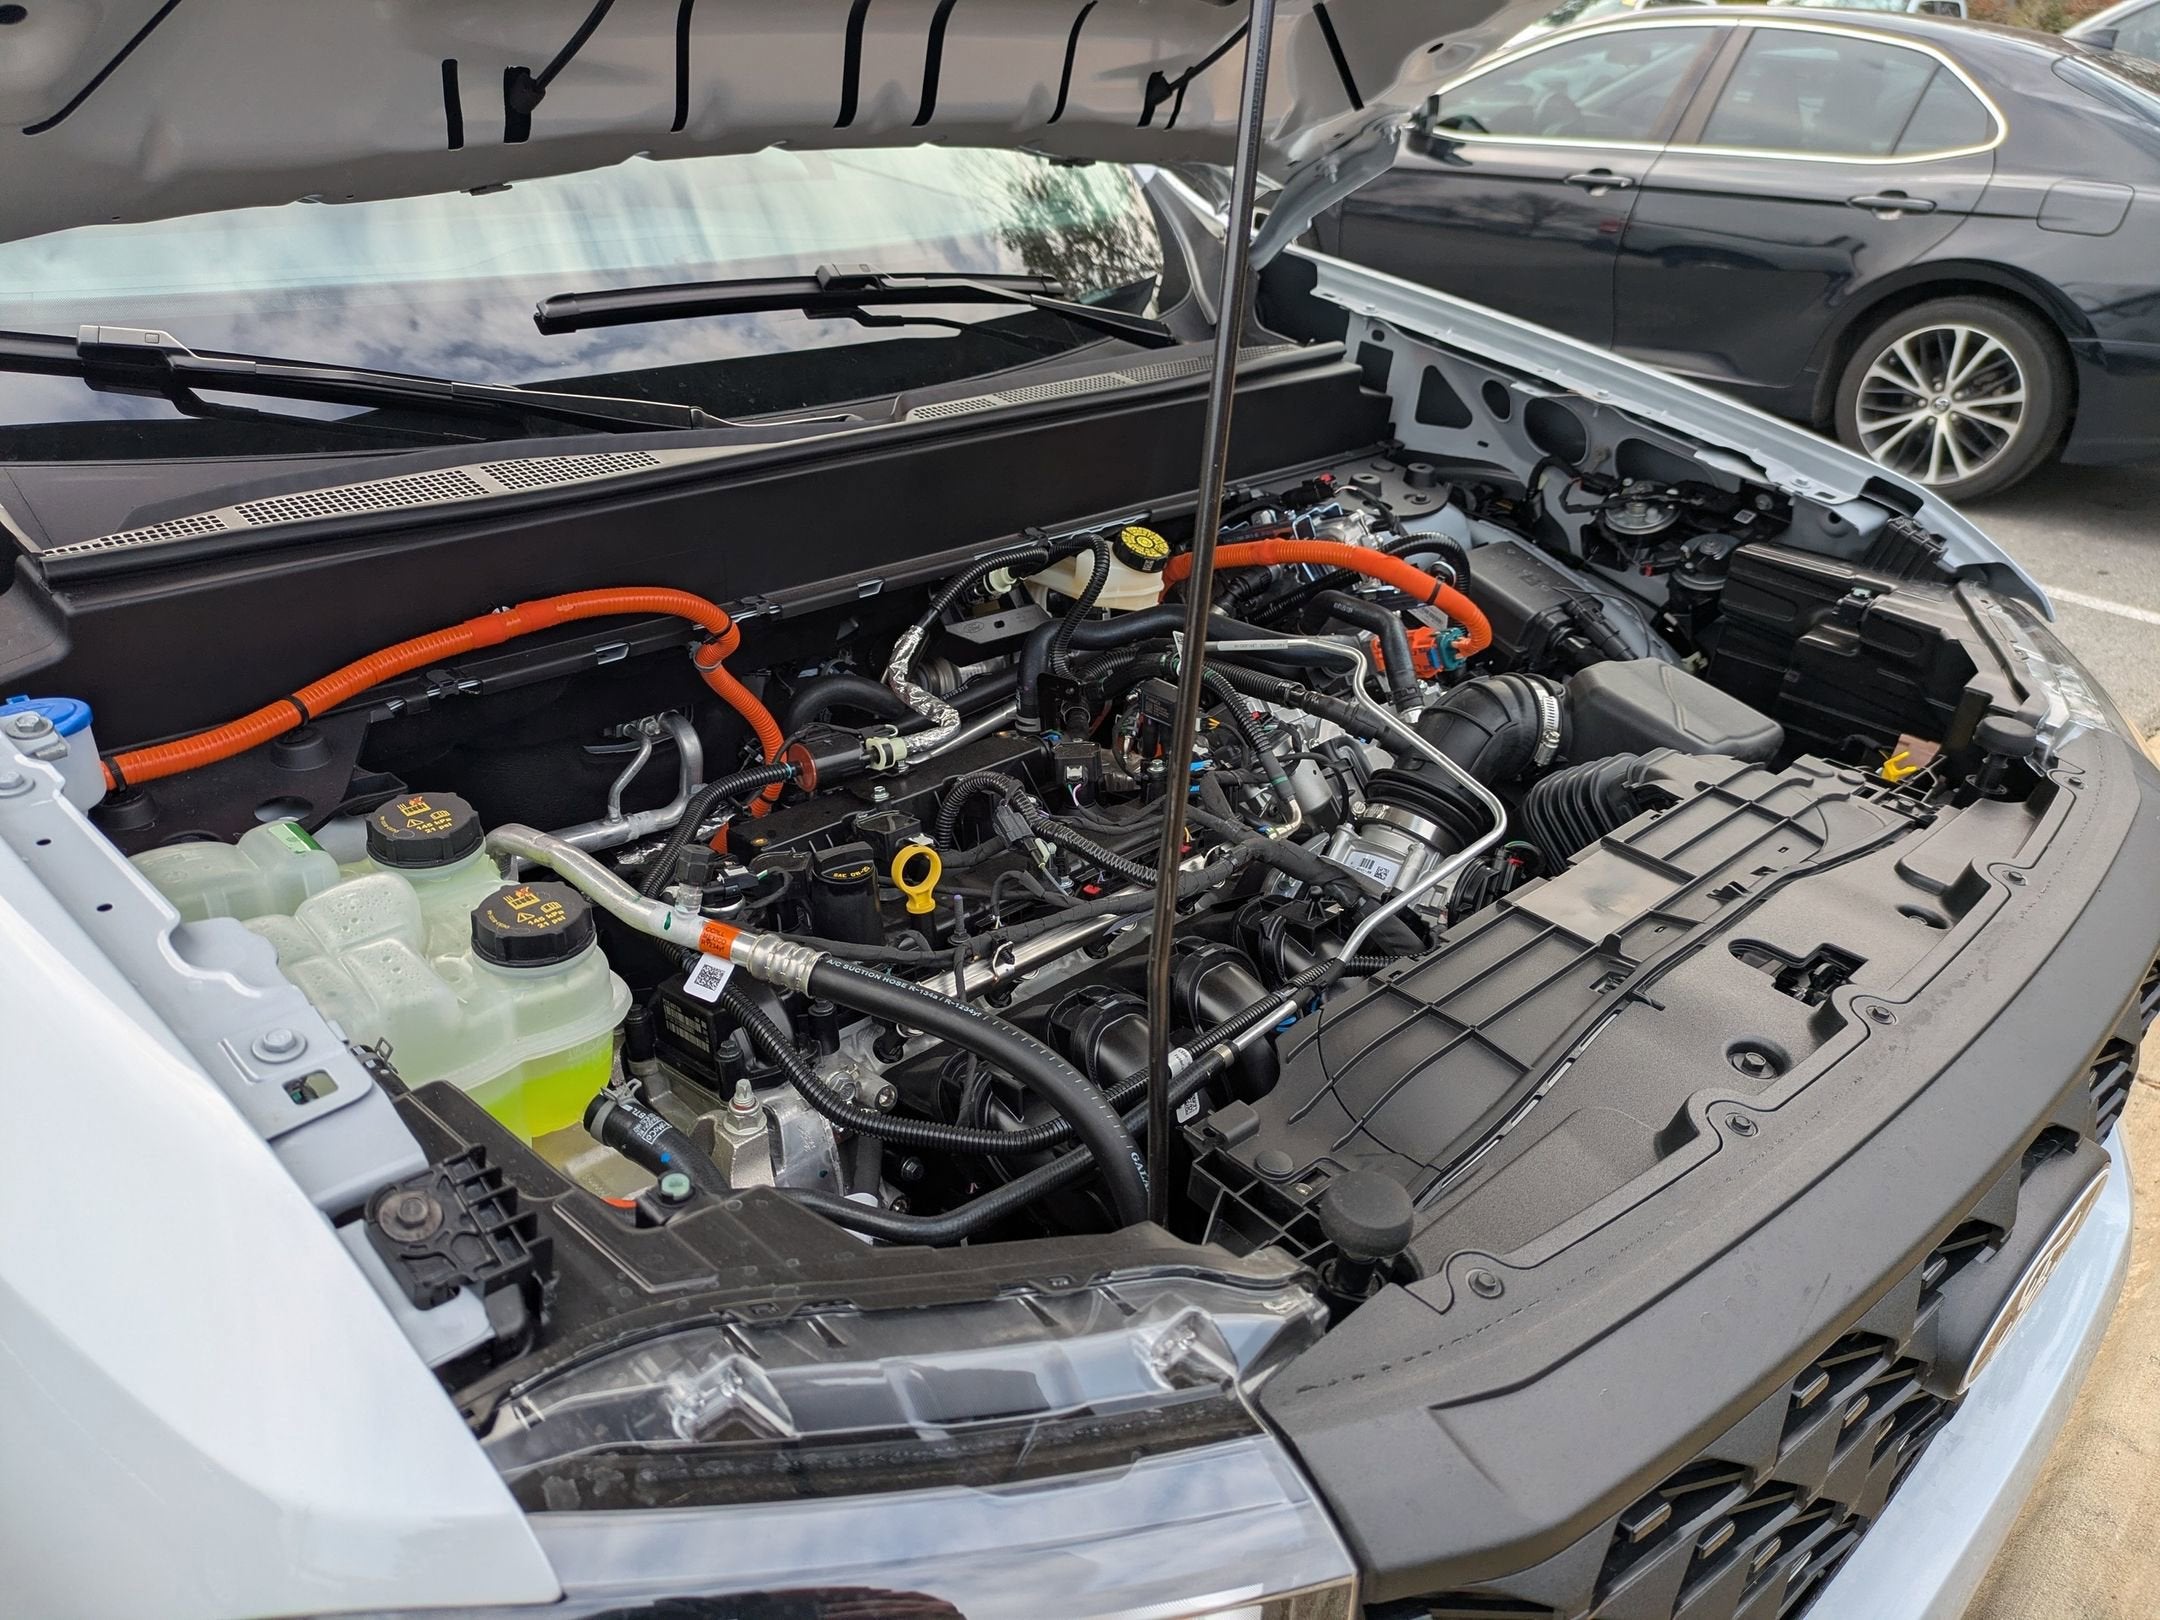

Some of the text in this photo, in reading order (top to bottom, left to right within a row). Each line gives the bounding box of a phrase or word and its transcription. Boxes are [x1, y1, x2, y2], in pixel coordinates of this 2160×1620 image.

[416, 817, 453, 831] 145 kPa
[438, 822, 453, 830] psi
[527, 910, 565, 925] 145 kPa
[537, 915, 566, 929] 21 psi
[826, 959, 842, 967] A/C
[842, 964, 881, 980] SUCTION
[882, 977, 908, 988] HOSE
[908, 985, 938, 1000] R-134a
[944, 998, 982, 1017] R-1234yf
